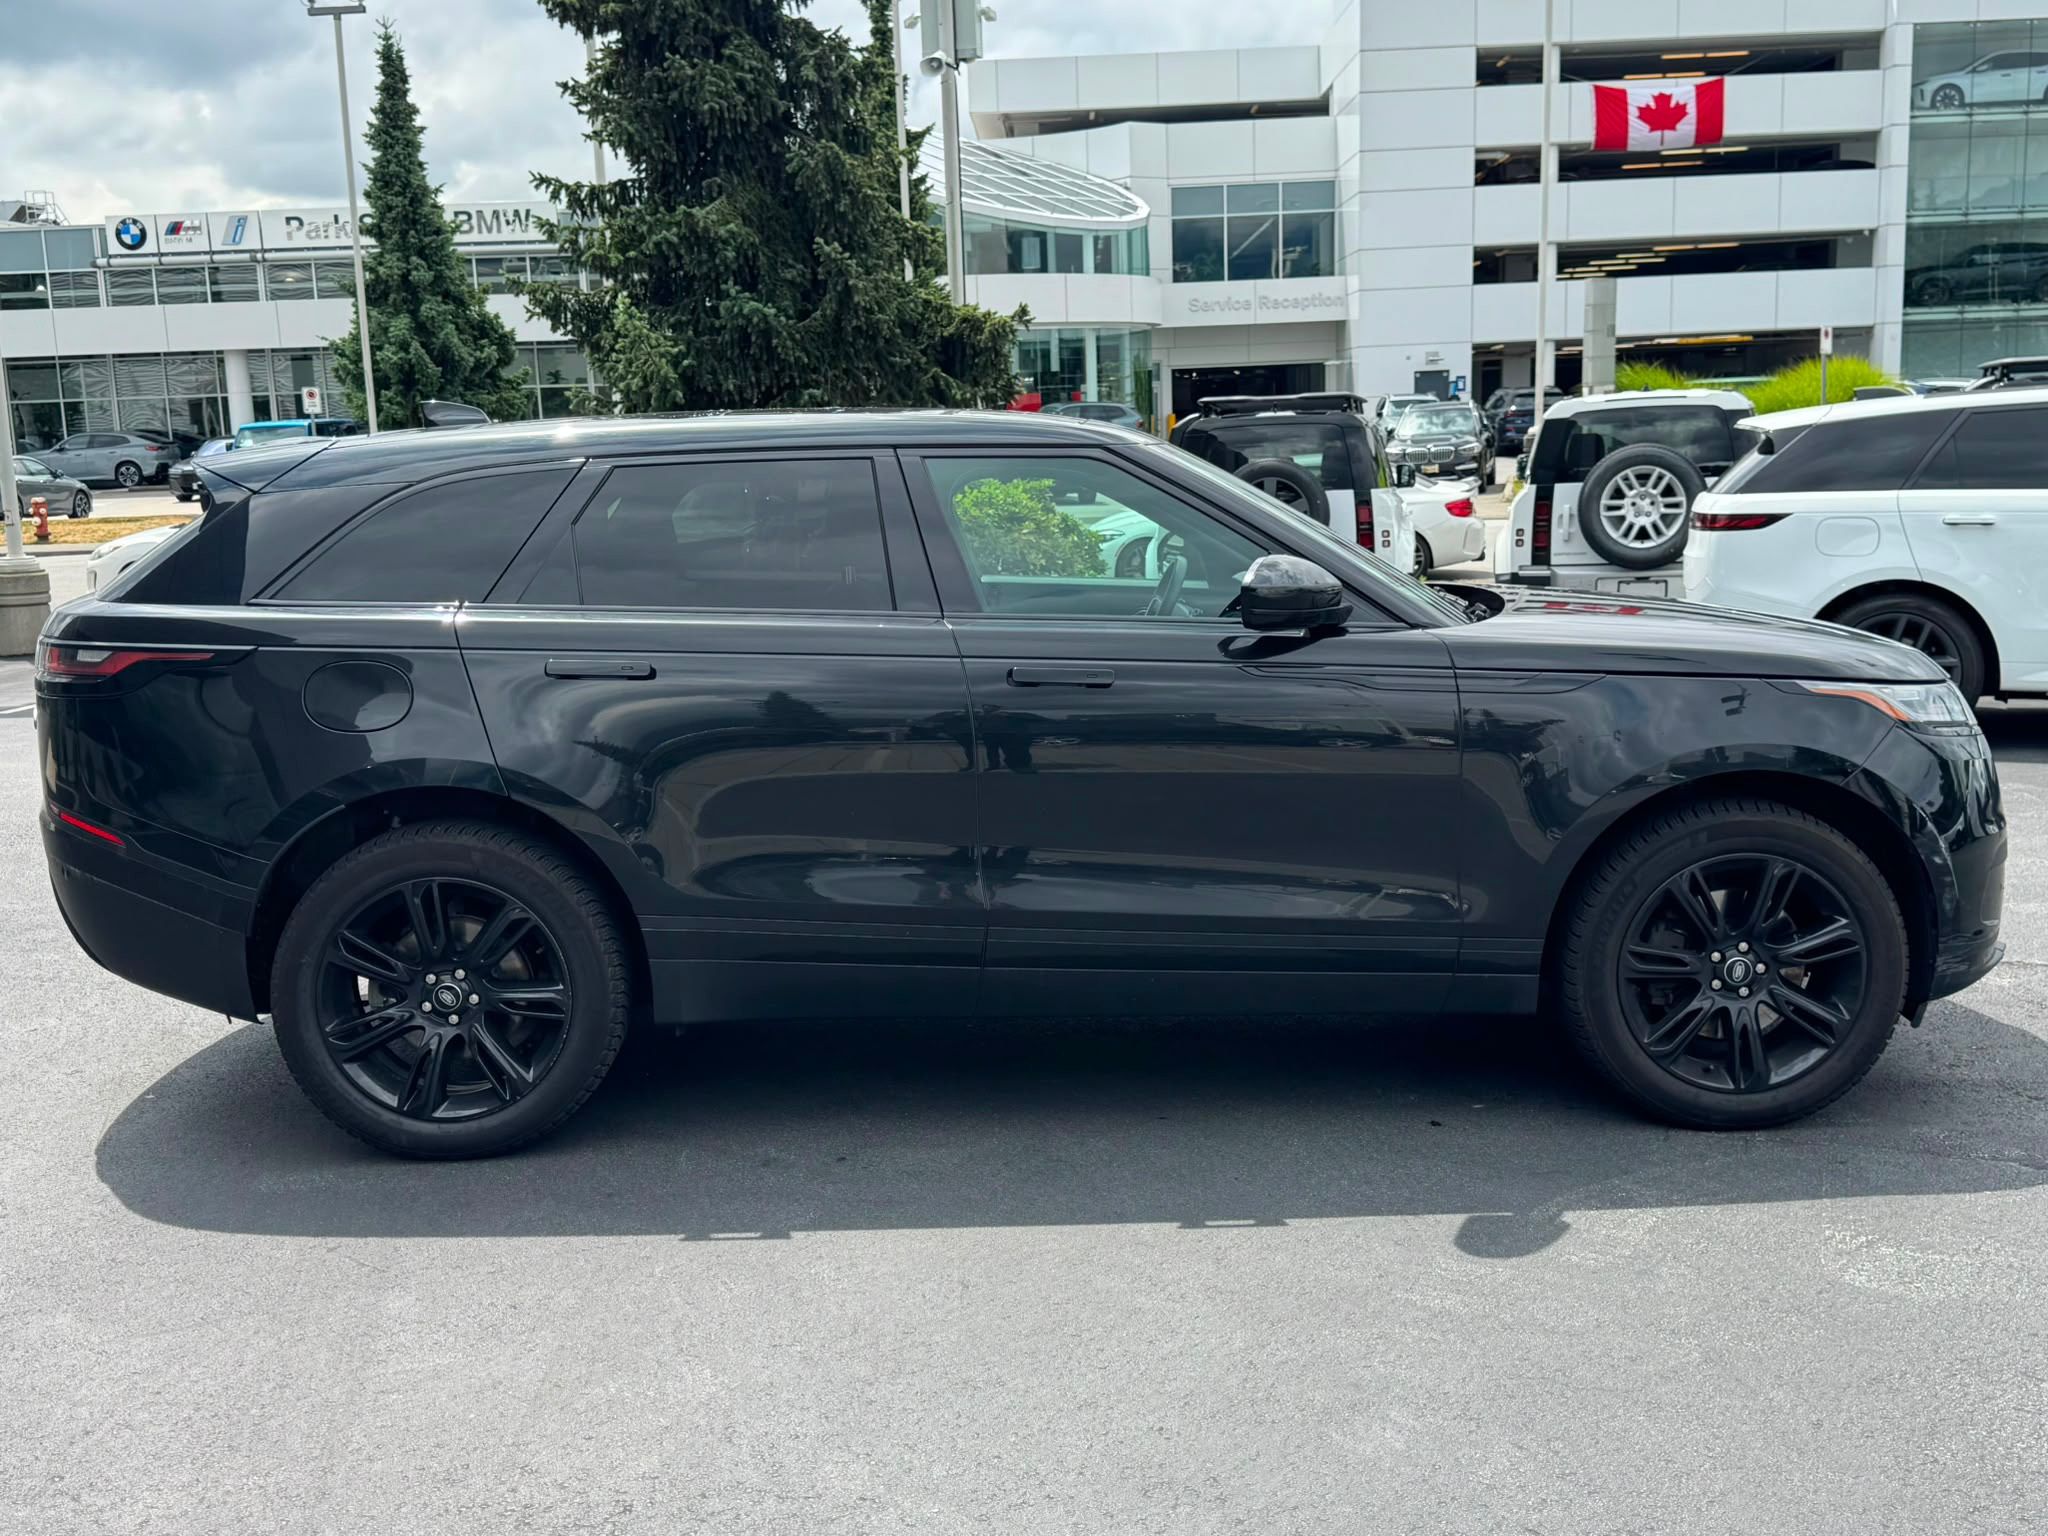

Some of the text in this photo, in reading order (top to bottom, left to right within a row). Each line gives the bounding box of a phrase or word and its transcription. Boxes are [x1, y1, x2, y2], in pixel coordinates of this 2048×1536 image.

[453, 208, 531, 234] BMW
[1188, 293, 1345, 313] Service Reception
